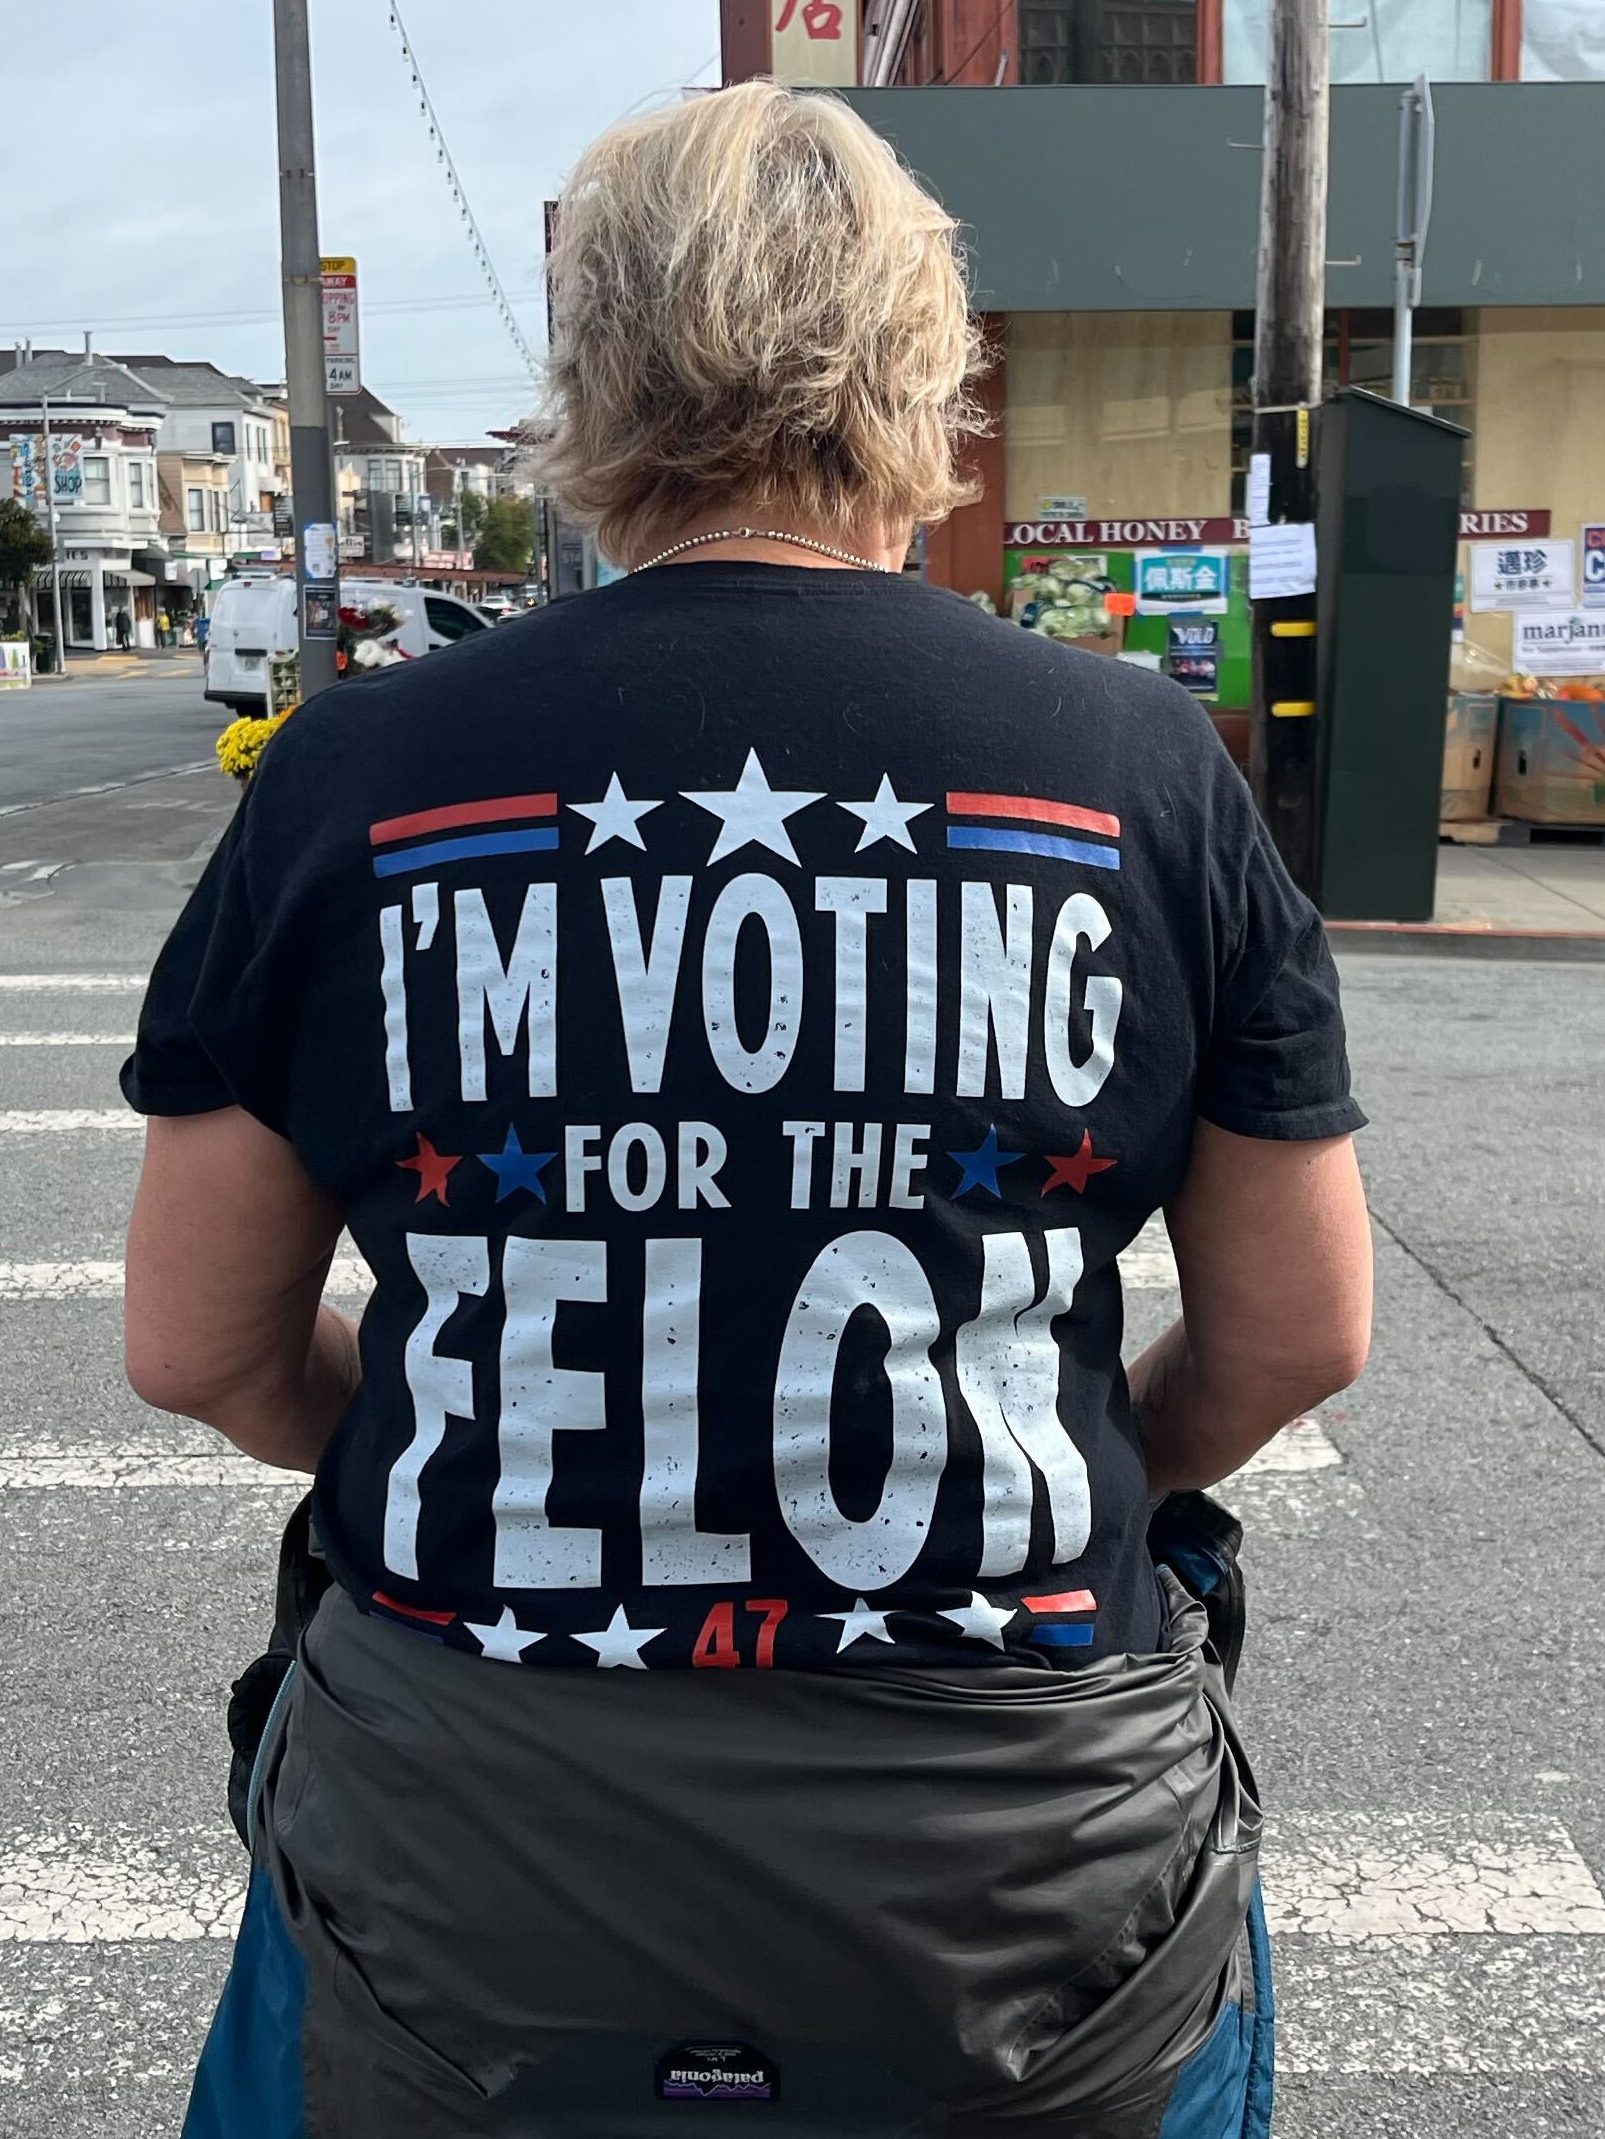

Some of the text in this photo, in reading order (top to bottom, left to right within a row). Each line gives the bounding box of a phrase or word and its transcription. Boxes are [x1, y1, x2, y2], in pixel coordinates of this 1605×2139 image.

[54, 474, 82, 494] SHOP
[1100, 520, 1208, 543] HONEY
[380, 873, 1123, 1111] I'M VOTING
[565, 1120, 932, 1212] FOR THE
[383, 1228, 1092, 1591] FELON
[692, 1600, 788, 1667] 47
[670, 2068, 764, 2083] patagonia
